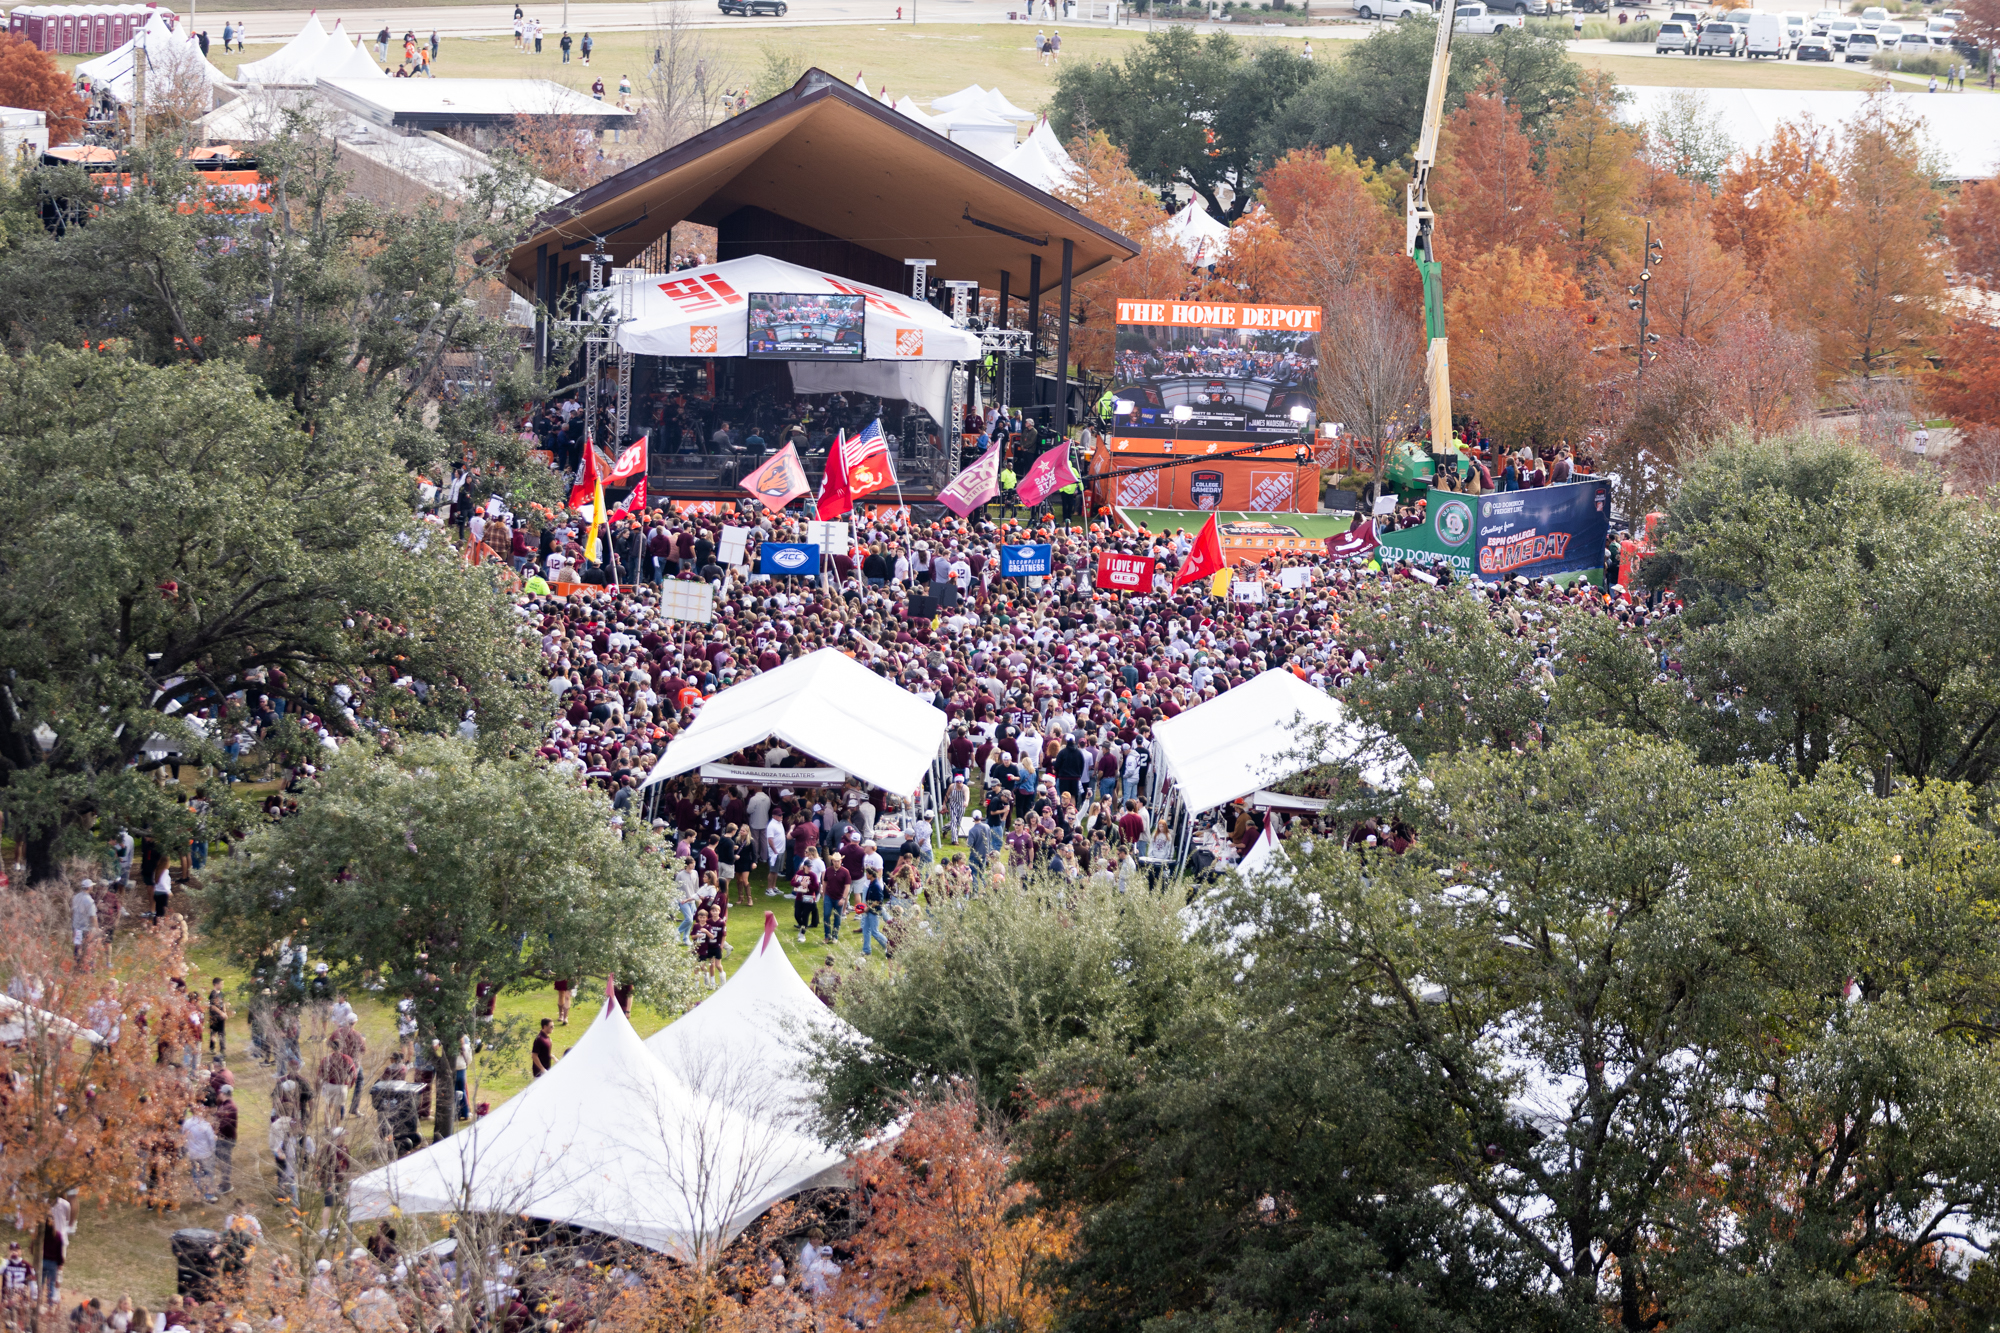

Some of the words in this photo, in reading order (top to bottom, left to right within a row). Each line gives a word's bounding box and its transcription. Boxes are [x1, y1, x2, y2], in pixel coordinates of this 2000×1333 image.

[1118, 303, 1165, 322] THE
[1172, 304, 1235, 326] HOME
[1242, 307, 1317, 329] DEPOT
[690, 325, 718, 353] HOME
[896, 329, 923, 356] HOME
[898, 331, 910, 342] THE
[1251, 419, 1265, 427] JAMES
[1121, 473, 1139, 487] THE
[1255, 477, 1273, 492] THE
[1117, 470, 1159, 507] HOME
[1132, 483, 1158, 507] DEPOT
[1250, 472, 1292, 512] HOME
[1265, 487, 1292, 512] DEPOT
[1493, 507, 1513, 515] FREIGHT
[1480, 525, 1504, 536] Greetings
[1504, 521, 1515, 532] from
[1487, 535, 1507, 546] ESPN
[1507, 528, 1537, 544] COLLEGE
[1379, 545, 1404, 561] OLD
[1480, 532, 1571, 573] GAMEDAY
[550, 559, 560, 569] 12
[1008, 564, 1045, 573] GREATNESS
[1106, 558, 1111, 570] I
[1111, 559, 1132, 573] LOVE
[1132, 561, 1146, 574] MY
[523, 568, 534, 578] 12
[957, 569, 965, 578] 12
[578, 741, 588, 757] 12
[6, 1270, 26, 1289] 12
